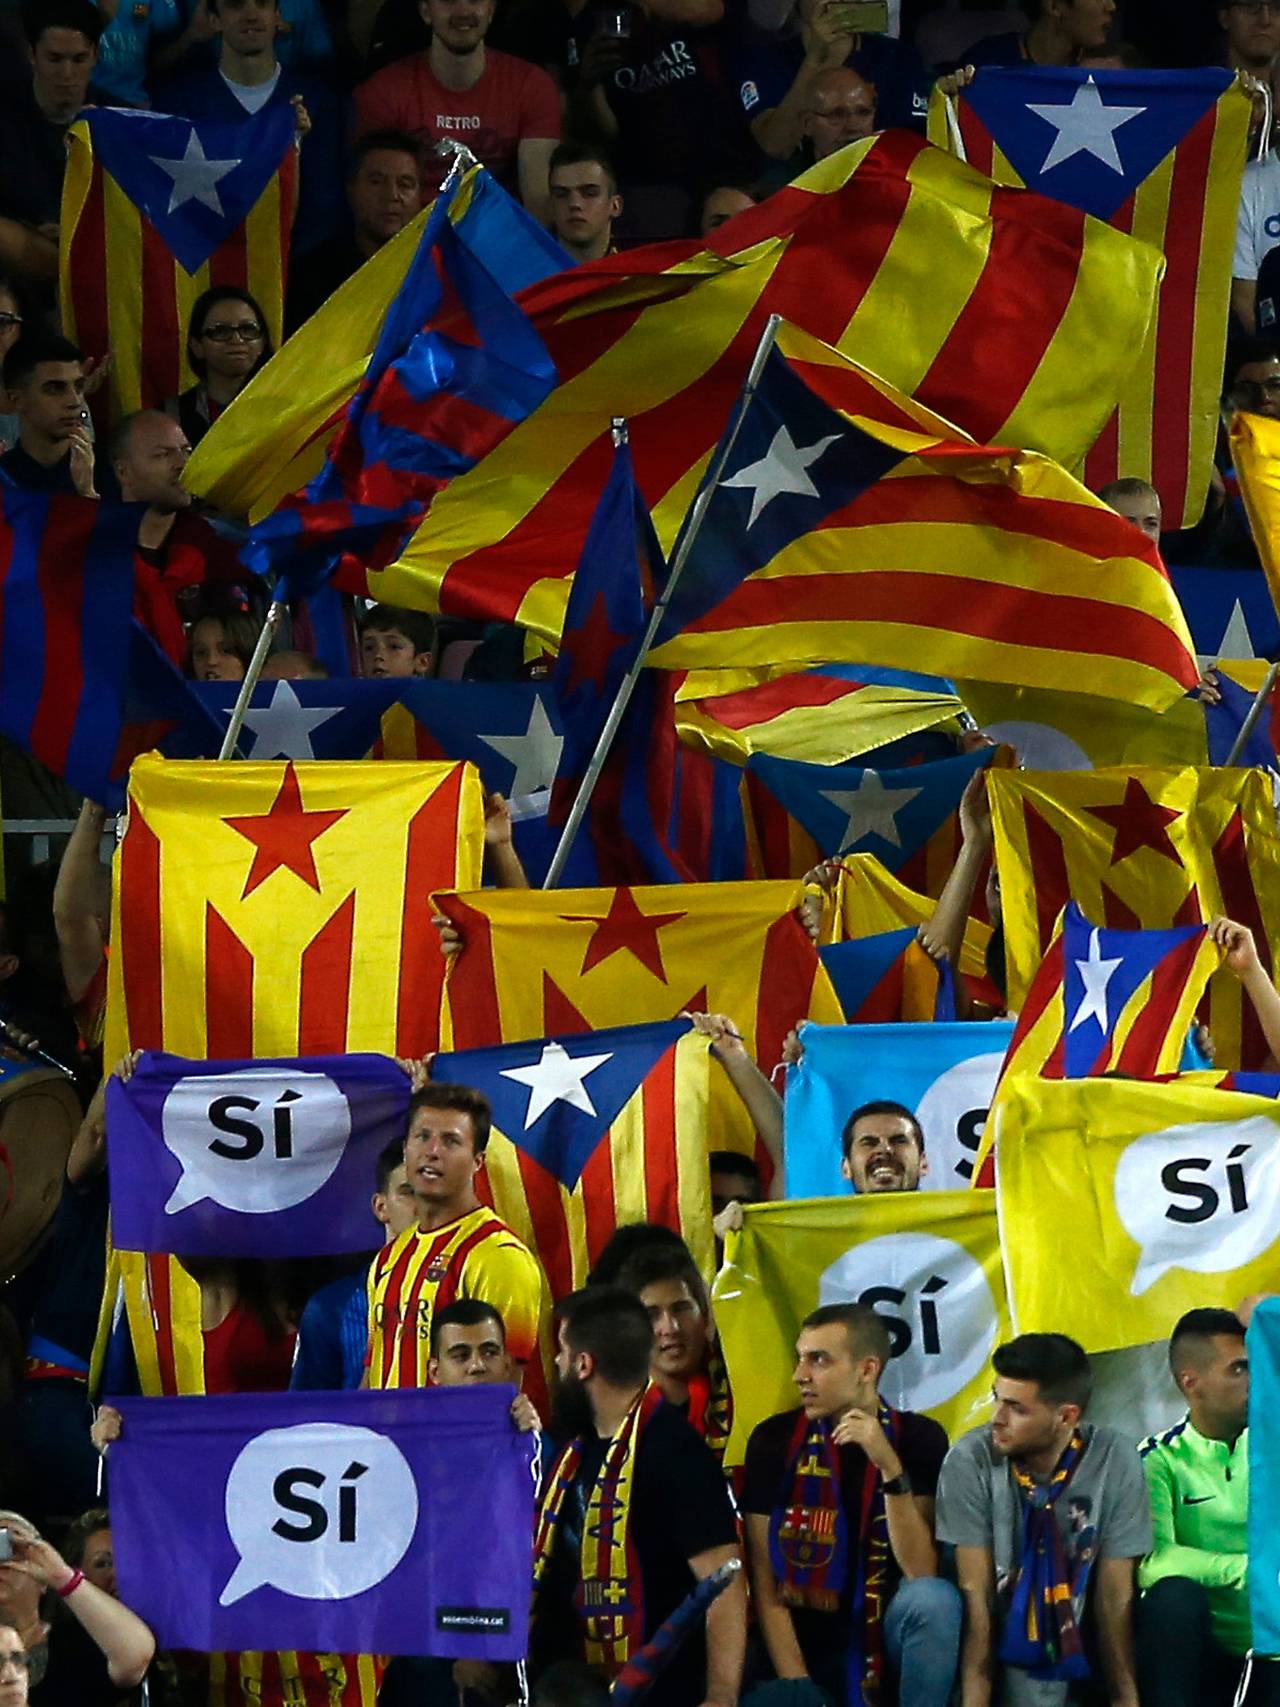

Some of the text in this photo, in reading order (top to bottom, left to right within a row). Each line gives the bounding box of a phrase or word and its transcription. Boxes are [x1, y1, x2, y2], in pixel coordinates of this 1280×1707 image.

[436, 114, 481, 129] RETRO
[208, 1089, 303, 1161] Sí
[1161, 1144, 1252, 1224] Sí
[858, 1275, 949, 1358] Sí
[271, 1461, 369, 1543] Sí
